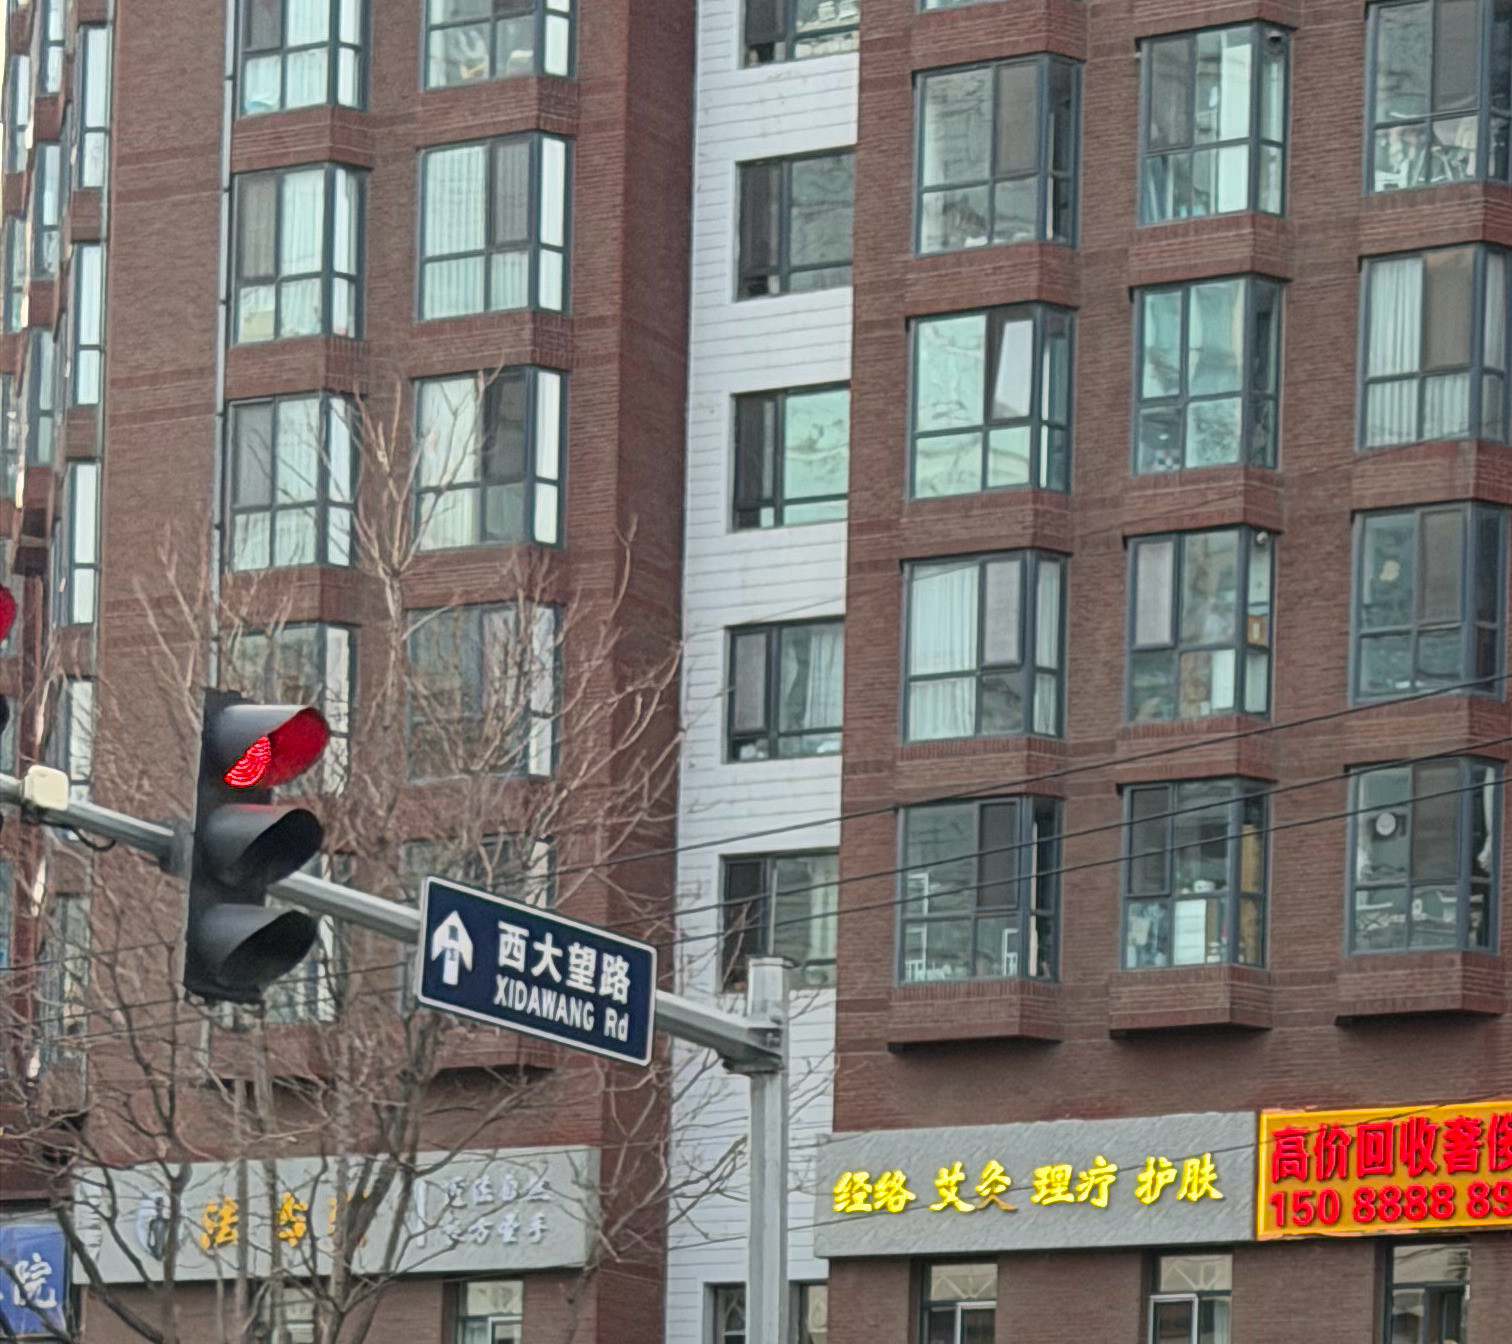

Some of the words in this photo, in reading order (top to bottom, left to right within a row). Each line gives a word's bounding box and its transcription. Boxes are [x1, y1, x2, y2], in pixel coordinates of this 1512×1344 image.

[498, 921, 631, 1005] 西大望路
[493, 974, 595, 1031] XIDAWANG
[604, 1007, 629, 1042] Rd
[833, 1170, 917, 1214] 经络
[930, 1160, 1018, 1213] 艾灸
[1031, 1155, 1118, 1208] 理疗
[1135, 1152, 1225, 1205] 护肤
[1270, 1188, 1341, 1228] 150
[1352, 1182, 1454, 1224] 8888
